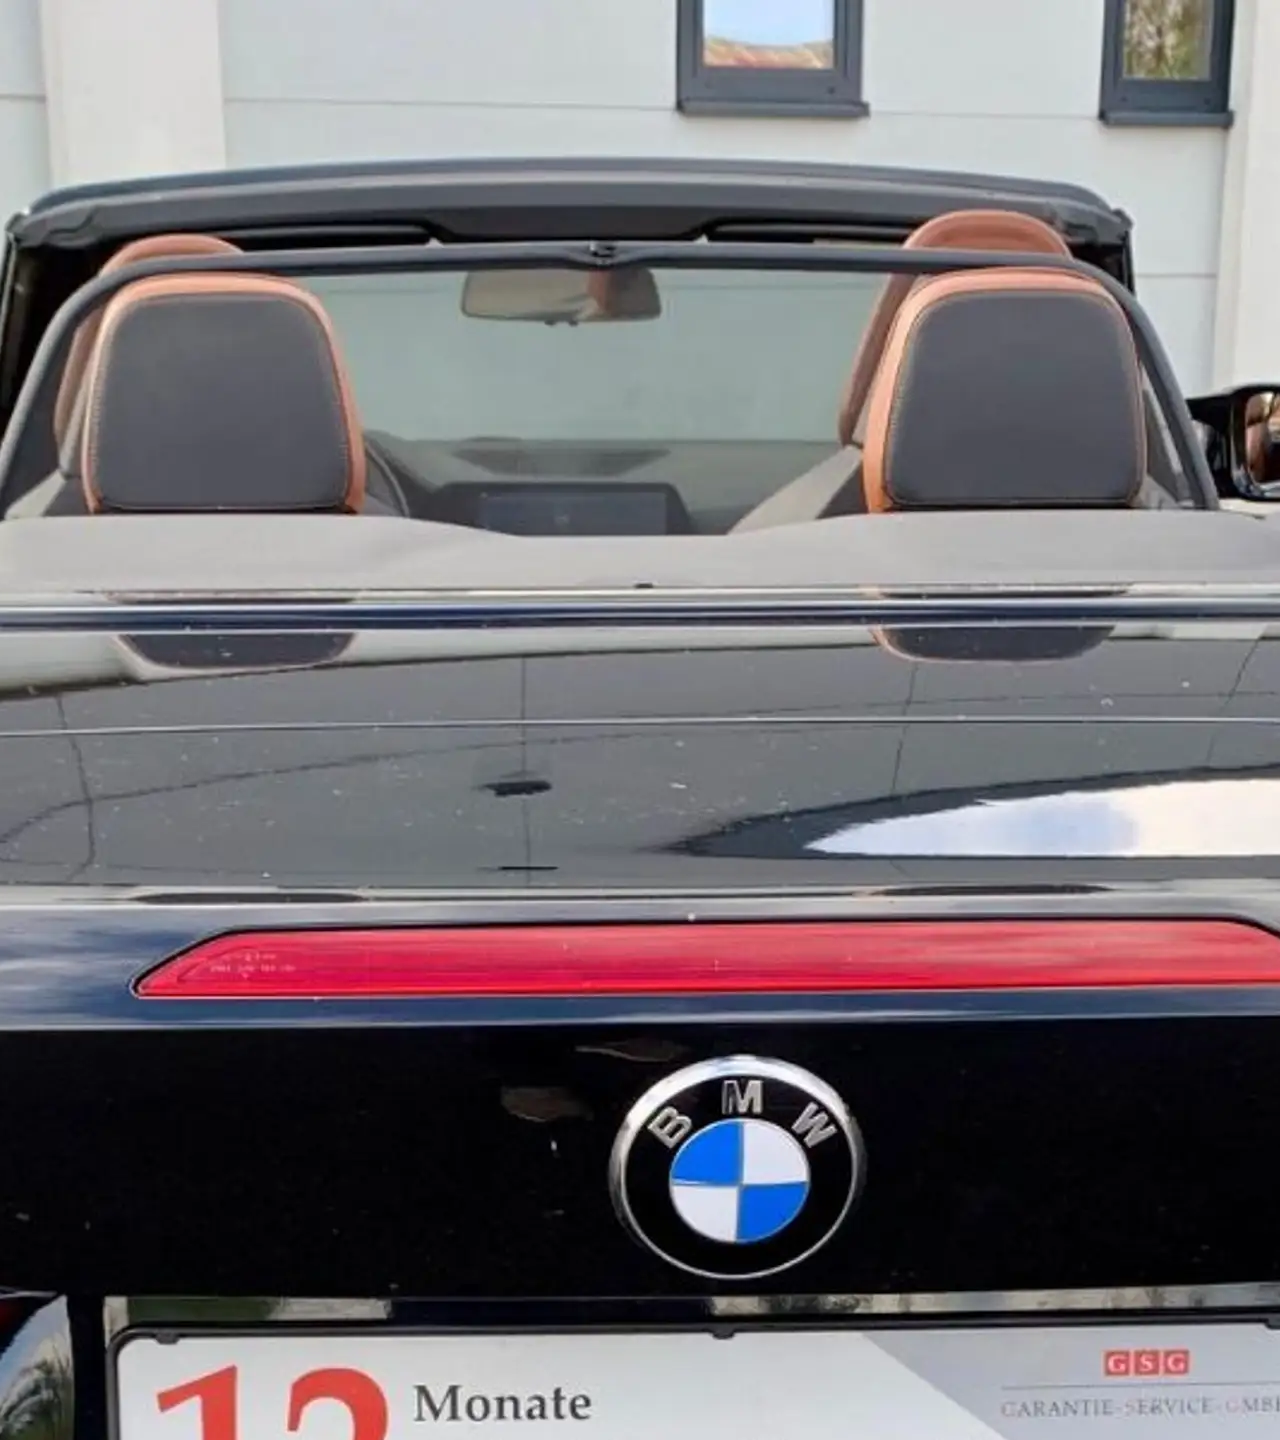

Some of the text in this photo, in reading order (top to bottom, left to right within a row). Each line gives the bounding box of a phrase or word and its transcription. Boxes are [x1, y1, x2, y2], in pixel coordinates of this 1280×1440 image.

[647, 1079, 838, 1149] BMW
[1105, 1350, 1190, 1376] GSG
[412, 1384, 593, 1422] Monate
